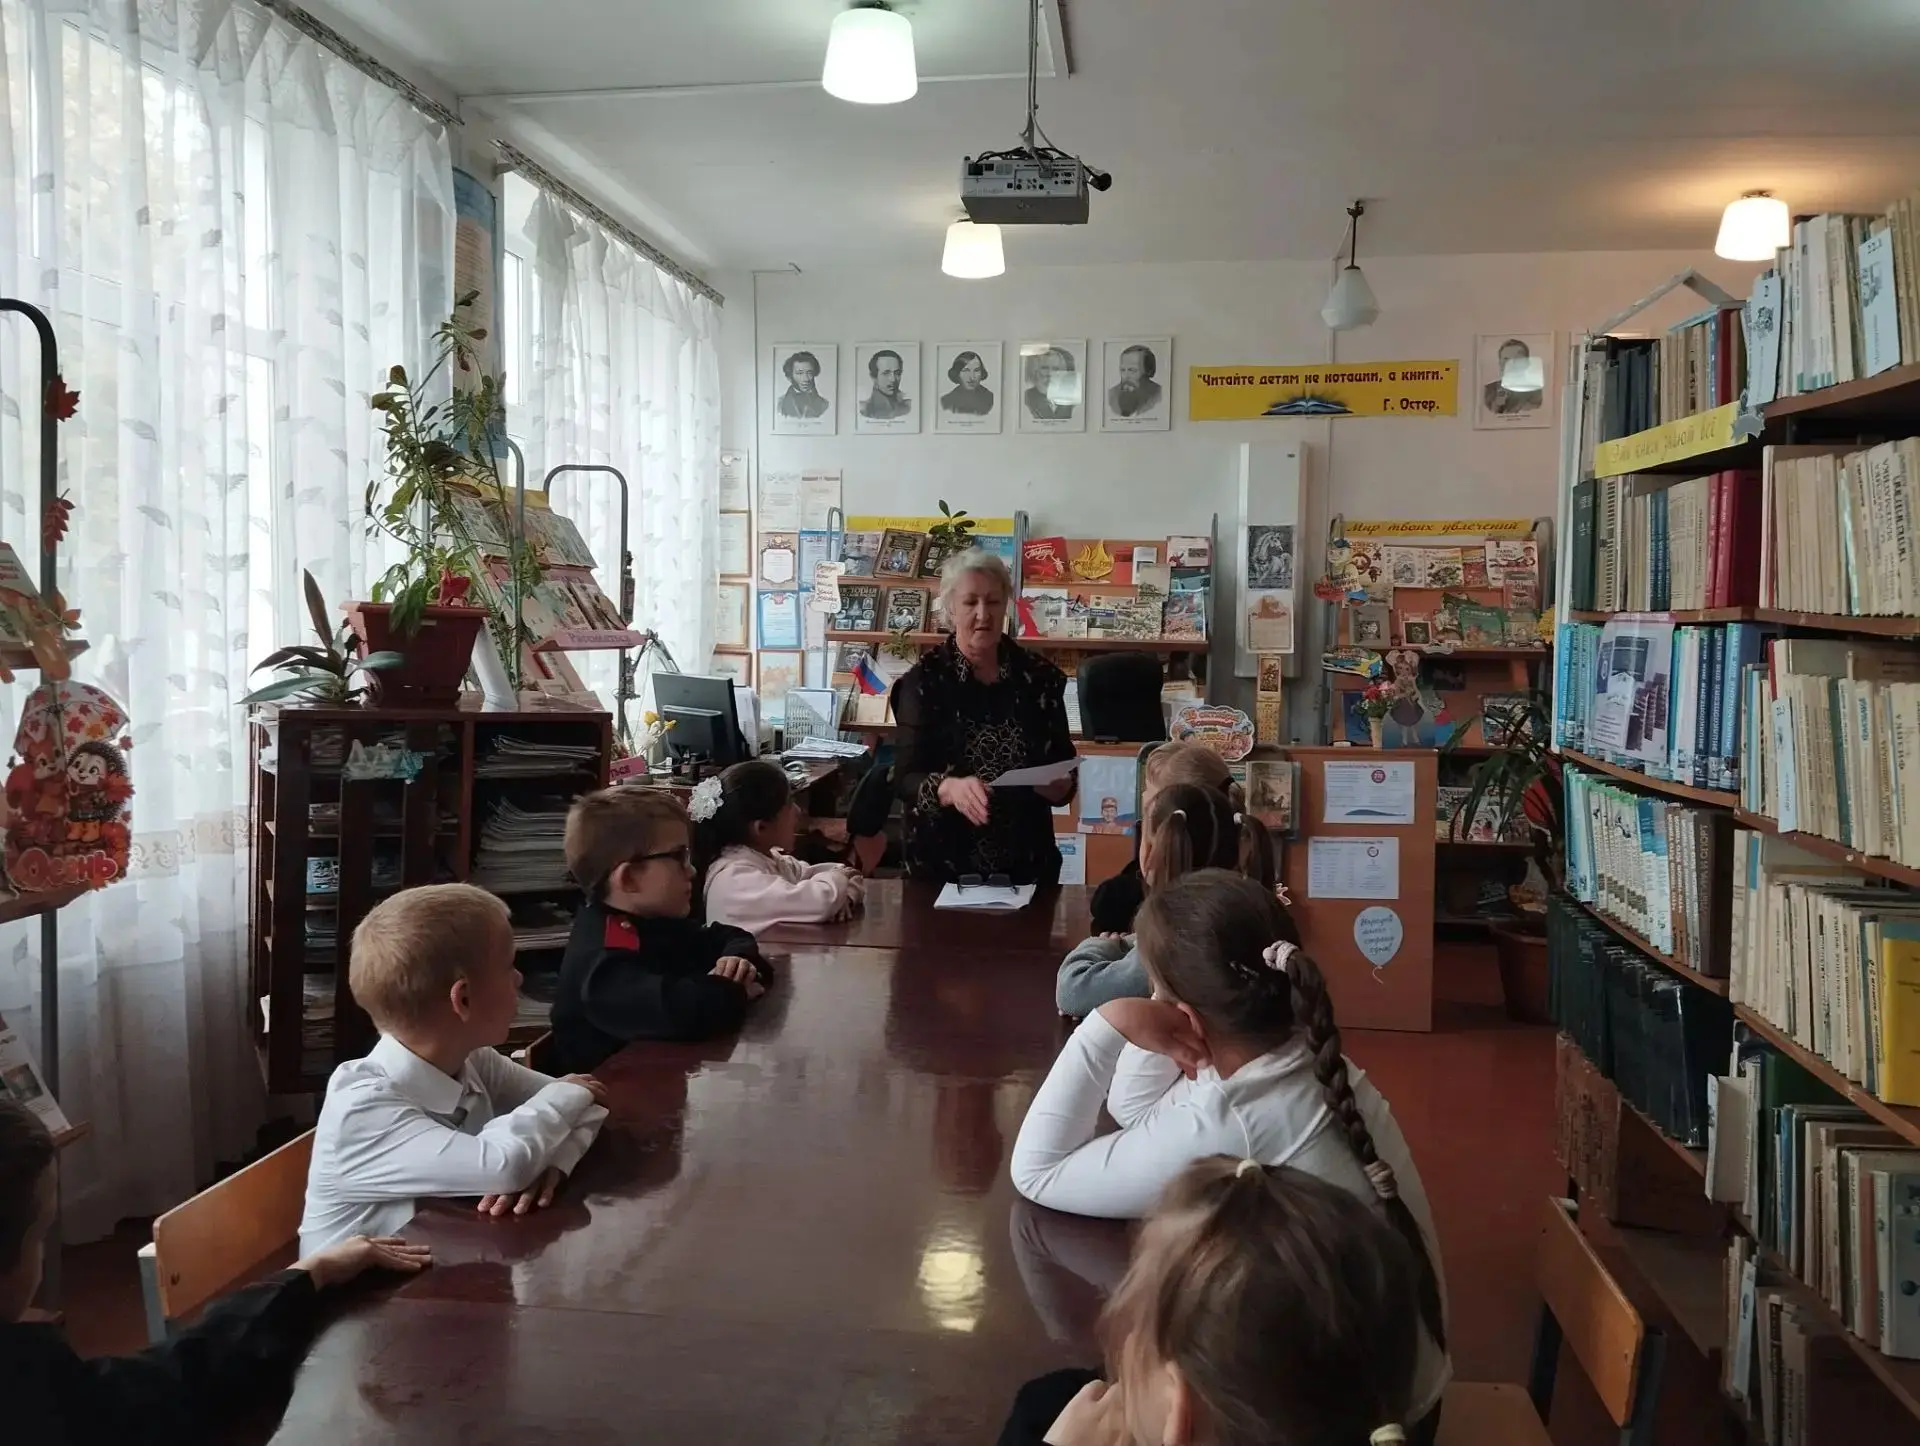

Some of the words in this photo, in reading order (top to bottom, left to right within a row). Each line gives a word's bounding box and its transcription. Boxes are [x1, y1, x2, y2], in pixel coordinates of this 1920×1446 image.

[1197, 373, 1255, 386] "Читайте
[1259, 374, 1299, 385] детям
[1304, 374, 1320, 384] не
[1324, 372, 1383, 383] нотации,
[1388, 371, 1397, 381] а
[1401, 367, 1450, 381] книги."
[1383, 398, 1395, 411] Г.
[1400, 397, 1440, 412] Остер.
[1347, 522, 1380, 534] Мир
[1388, 523, 1434, 532] твоих
[1442, 521, 1520, 534] увлечений
[1699, 824, 1708, 859] СПОРТ
[16, 848, 119, 890] Осень
